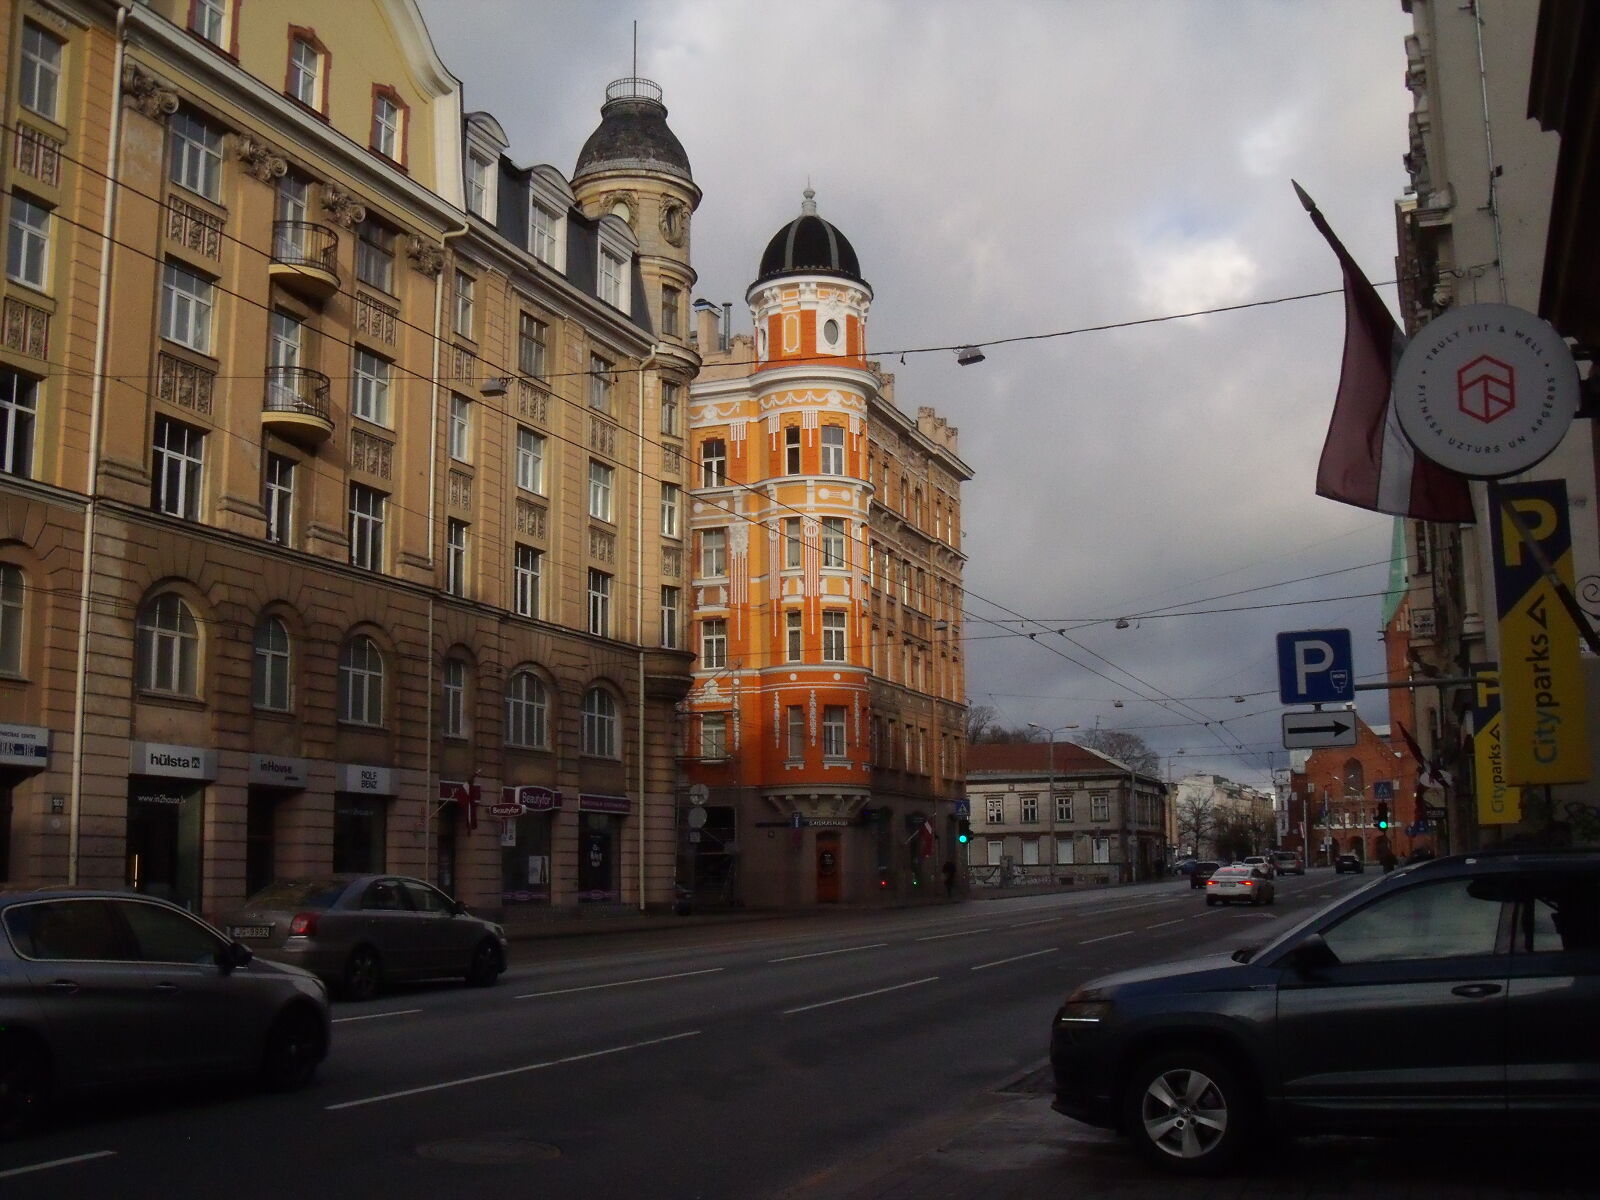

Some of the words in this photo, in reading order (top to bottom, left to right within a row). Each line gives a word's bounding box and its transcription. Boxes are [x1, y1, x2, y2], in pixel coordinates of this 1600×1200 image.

[1426, 331, 1459, 360] TRULY
[1468, 324, 1488, 333] FIT
[1498, 325, 1505, 333] &
[1515, 330, 1543, 356] WELL
[1418, 384, 1442, 436] FITNESA
[1448, 437, 1500, 453] UZTURS
[1508, 435, 1525, 448] UN
[1501, 497, 1557, 568] P
[1294, 640, 1334, 694] P
[1525, 634, 1561, 764] Cityparks
[150, 753, 190, 768] hülsta
[361, 770, 377, 779] ROLF
[1488, 744, 1505, 813] Cityparks
[361, 780, 377, 789] BENZ
[522, 792, 551, 808] Beautyfor
